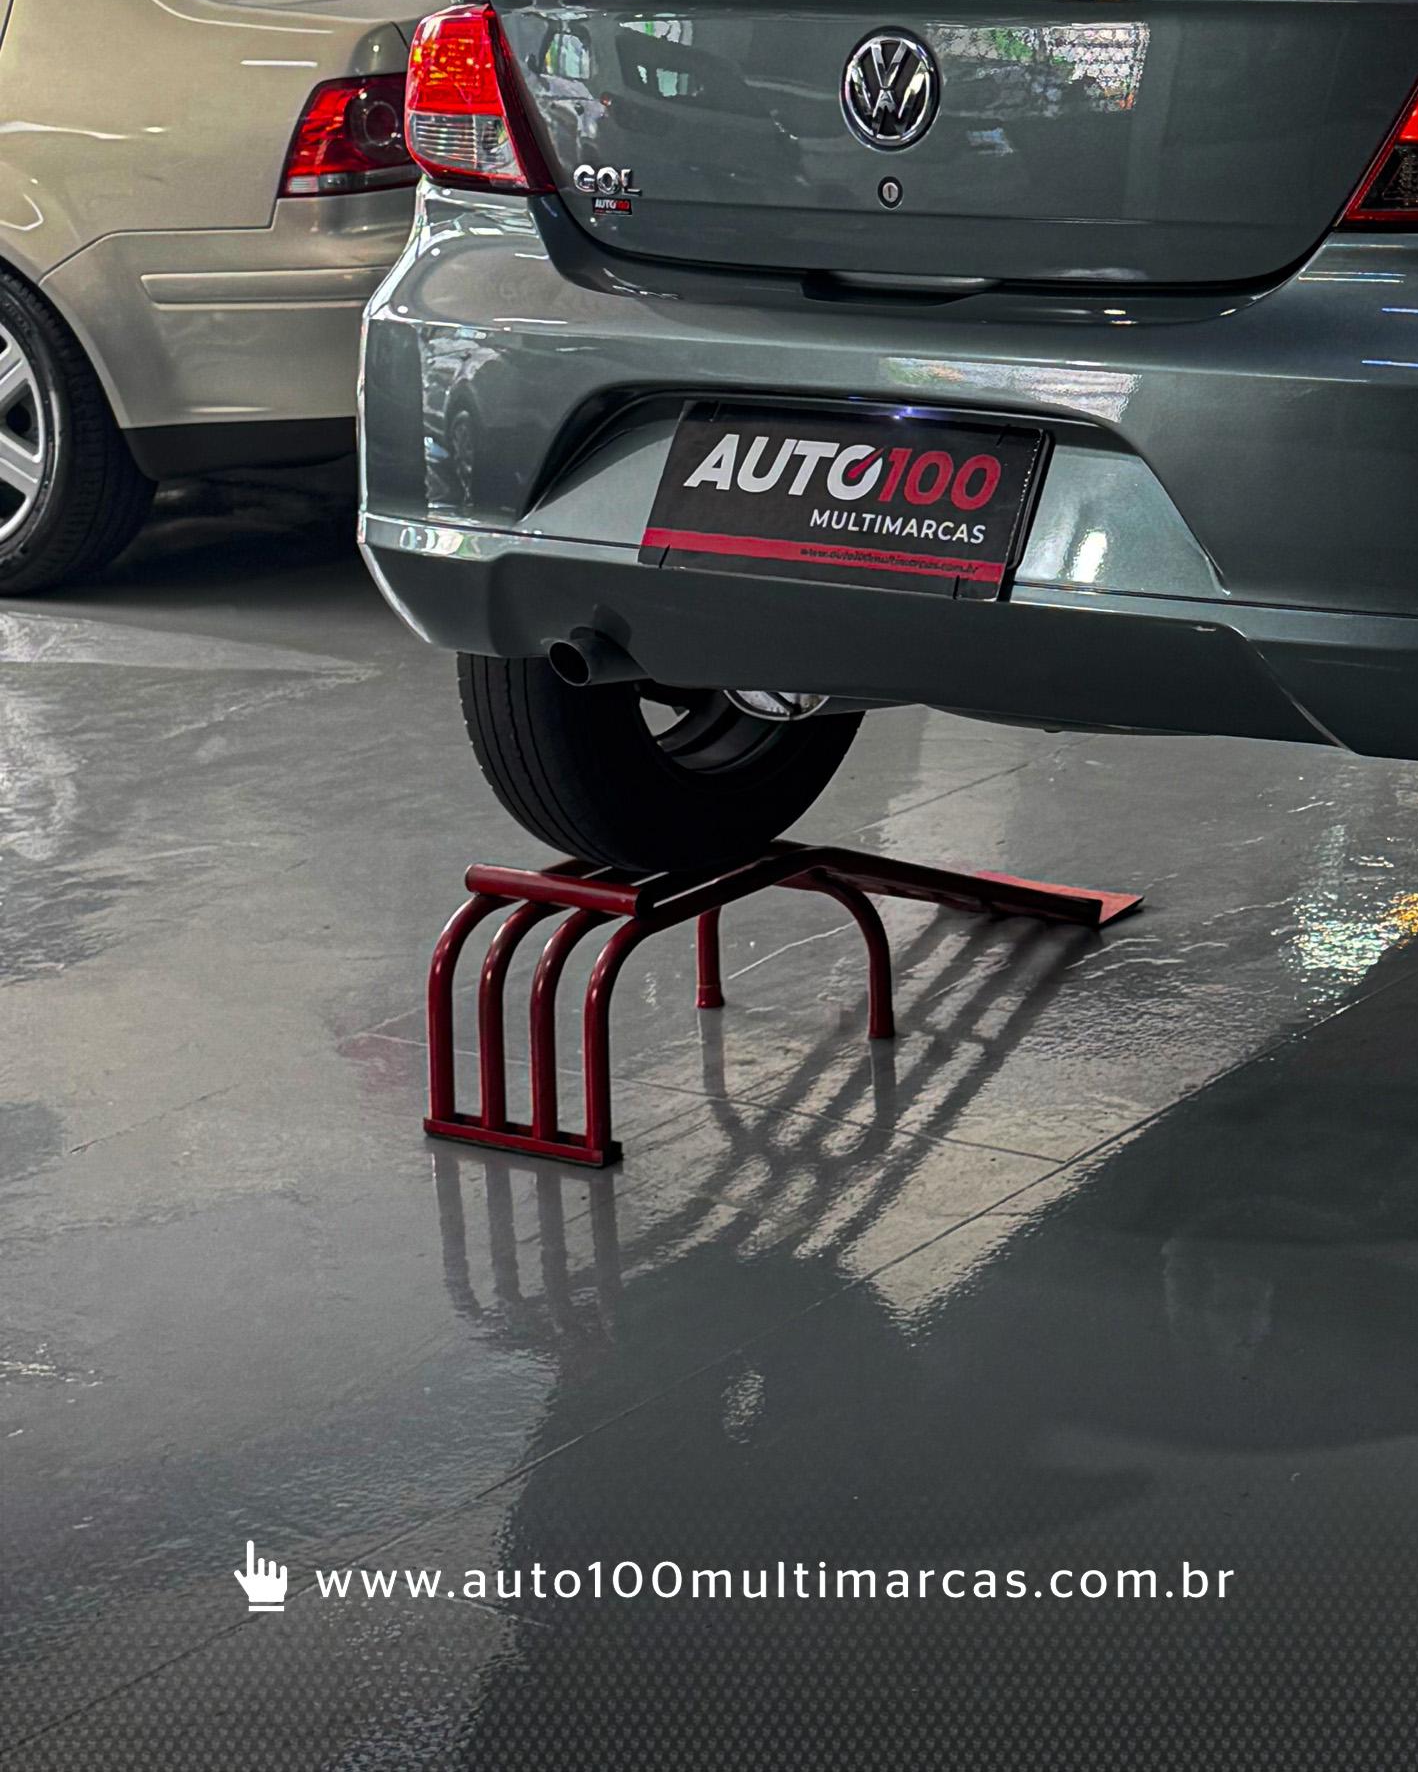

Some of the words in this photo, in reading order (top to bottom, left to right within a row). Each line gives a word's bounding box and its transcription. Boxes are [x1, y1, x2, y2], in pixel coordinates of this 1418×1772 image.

[573, 164, 642, 196] GOL
[684, 434, 1001, 511] AUTO100
[809, 508, 987, 545] MULTIMARCAS
